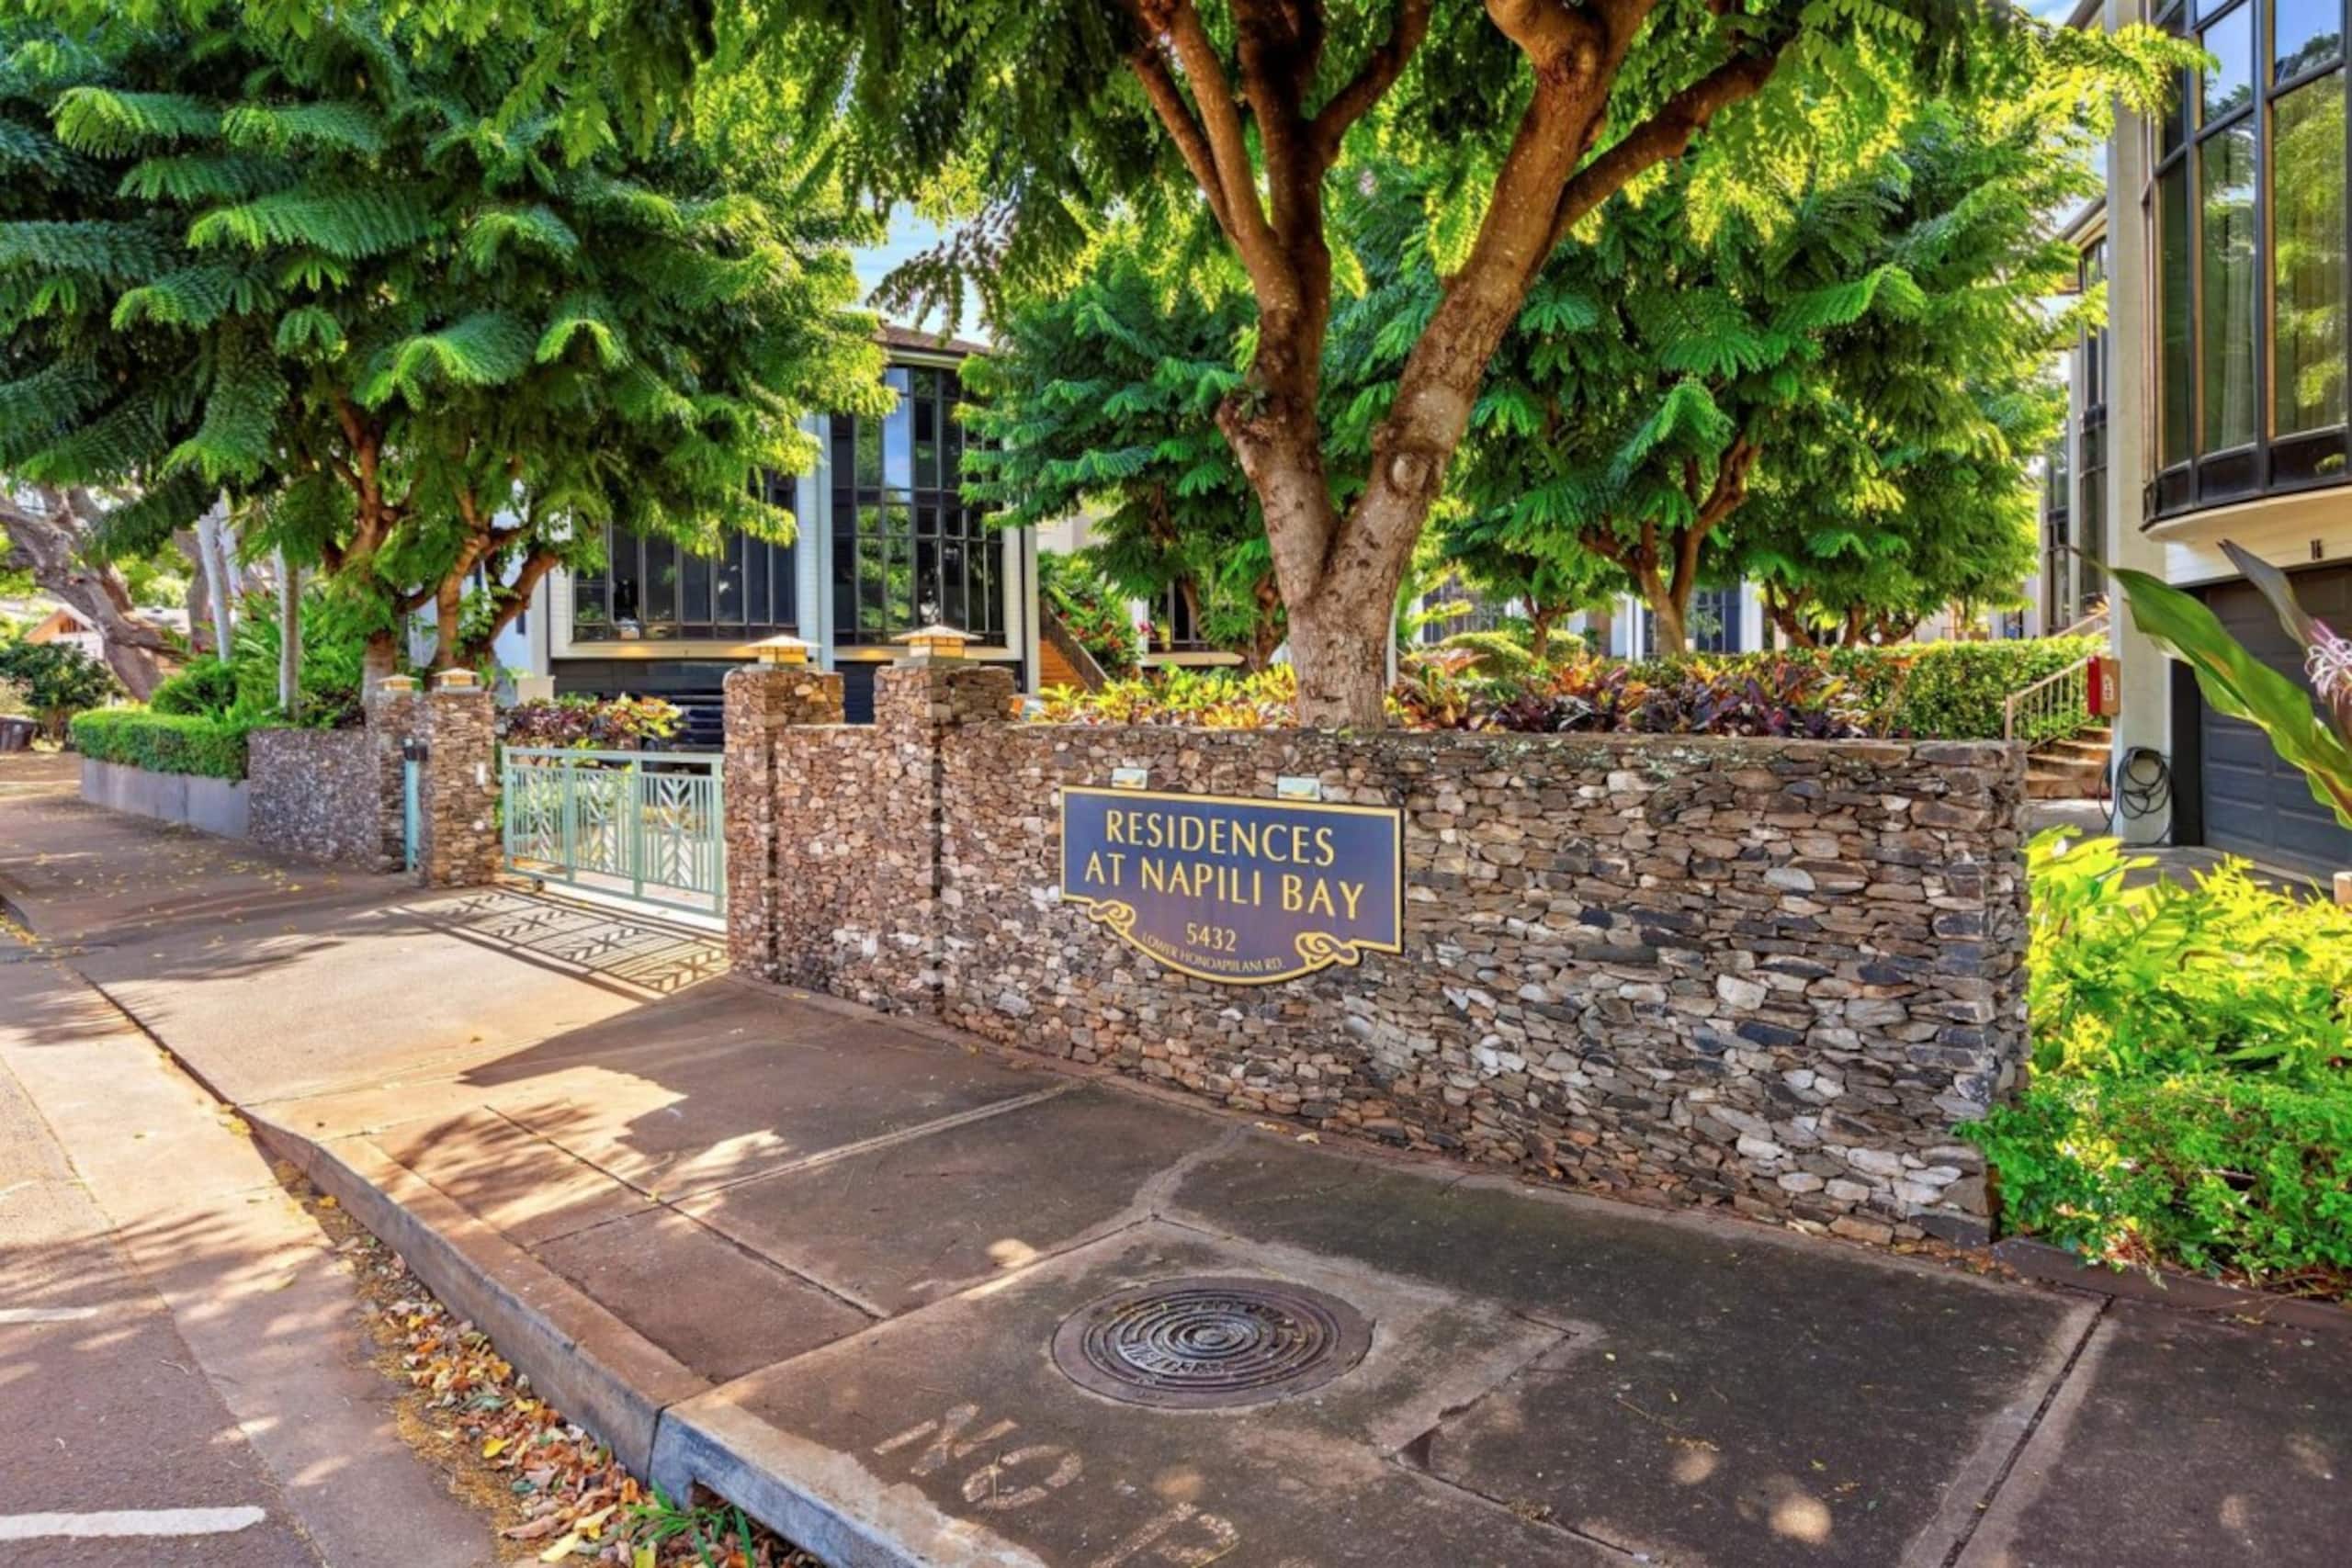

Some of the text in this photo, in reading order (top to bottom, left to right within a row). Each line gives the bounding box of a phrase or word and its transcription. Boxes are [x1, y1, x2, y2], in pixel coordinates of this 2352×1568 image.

[1106, 810, 1335, 866] RESIDENCES
[1085, 852, 1364, 919] AT NAPILI BAY
[1142, 931, 1178, 957] LOWER
[1186, 922, 1237, 953] 5432
